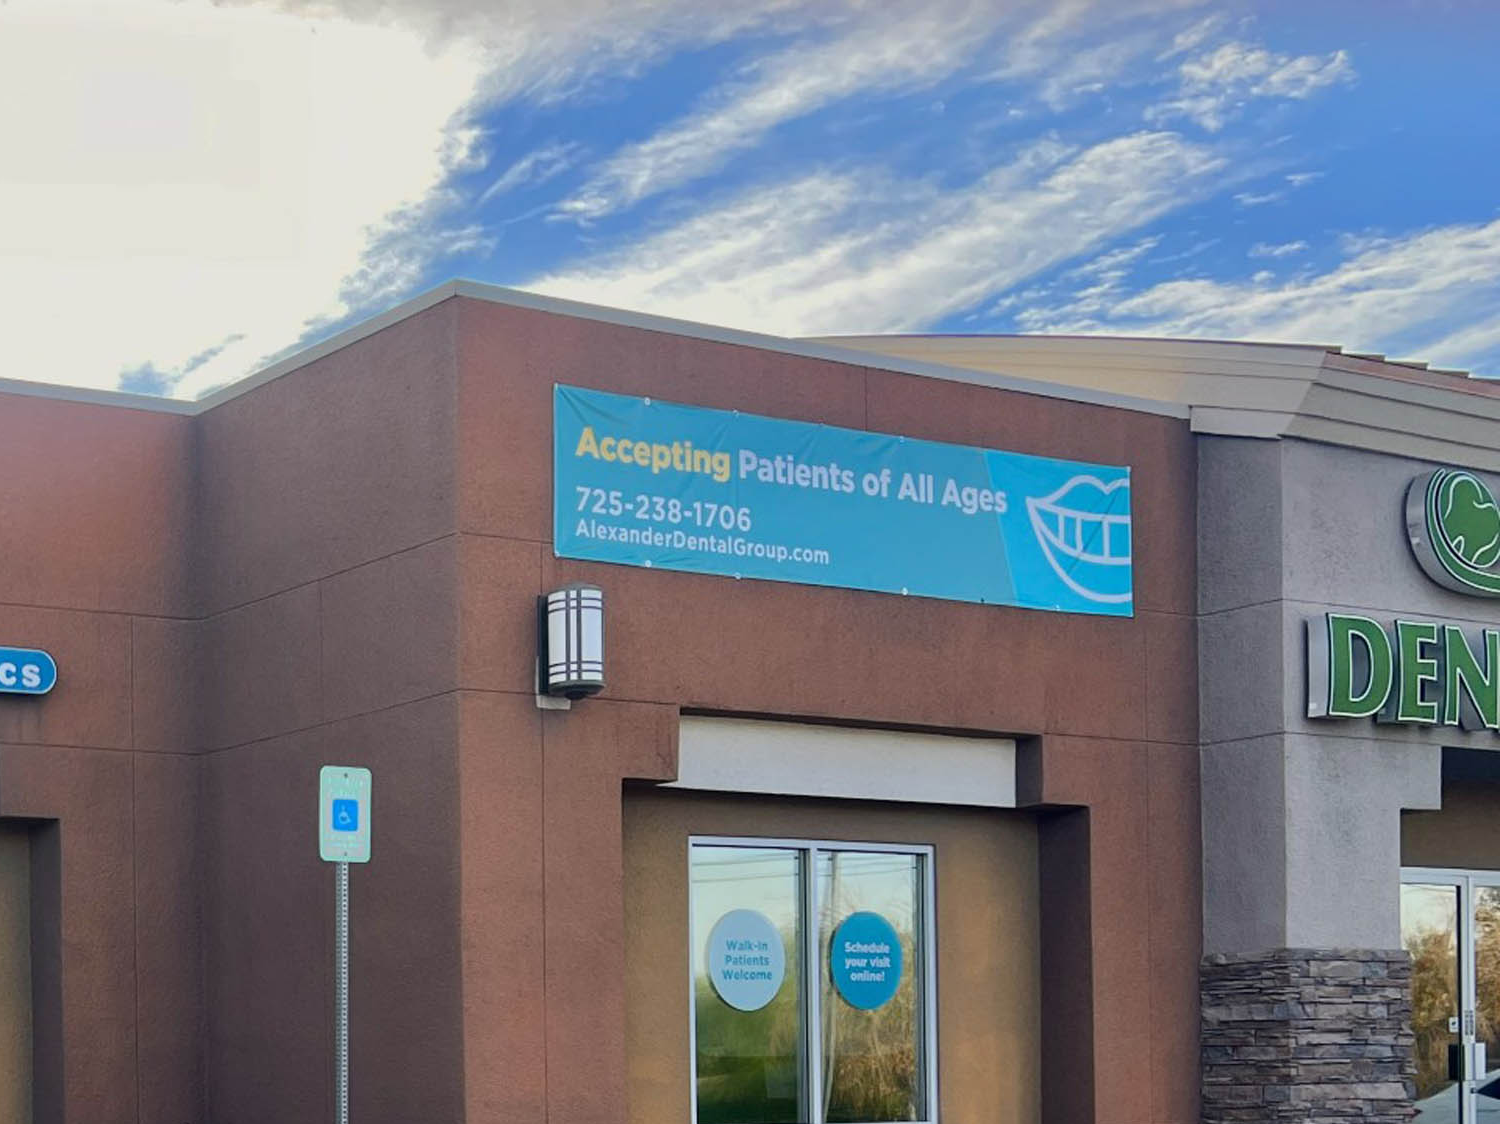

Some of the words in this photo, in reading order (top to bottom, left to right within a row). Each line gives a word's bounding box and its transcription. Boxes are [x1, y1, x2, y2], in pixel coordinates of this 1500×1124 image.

[575, 426, 731, 483] Accepting
[739, 449, 855, 493] Patients
[862, 468, 892, 498] of
[898, 472, 934, 504] All
[941, 478, 1008, 514] Ages
[575, 486, 752, 532] 725-238-1706
[575, 518, 830, 565] AlexanderDentalGroup.com
[726, 940, 768, 951] Walk-in
[844, 941, 890, 954] Schedule
[724, 955, 770, 967] Patients
[845, 957, 867, 969] your
[869, 957, 891, 968] visit
[722, 970, 773, 981] Welcome
[850, 970, 885, 982] online!
